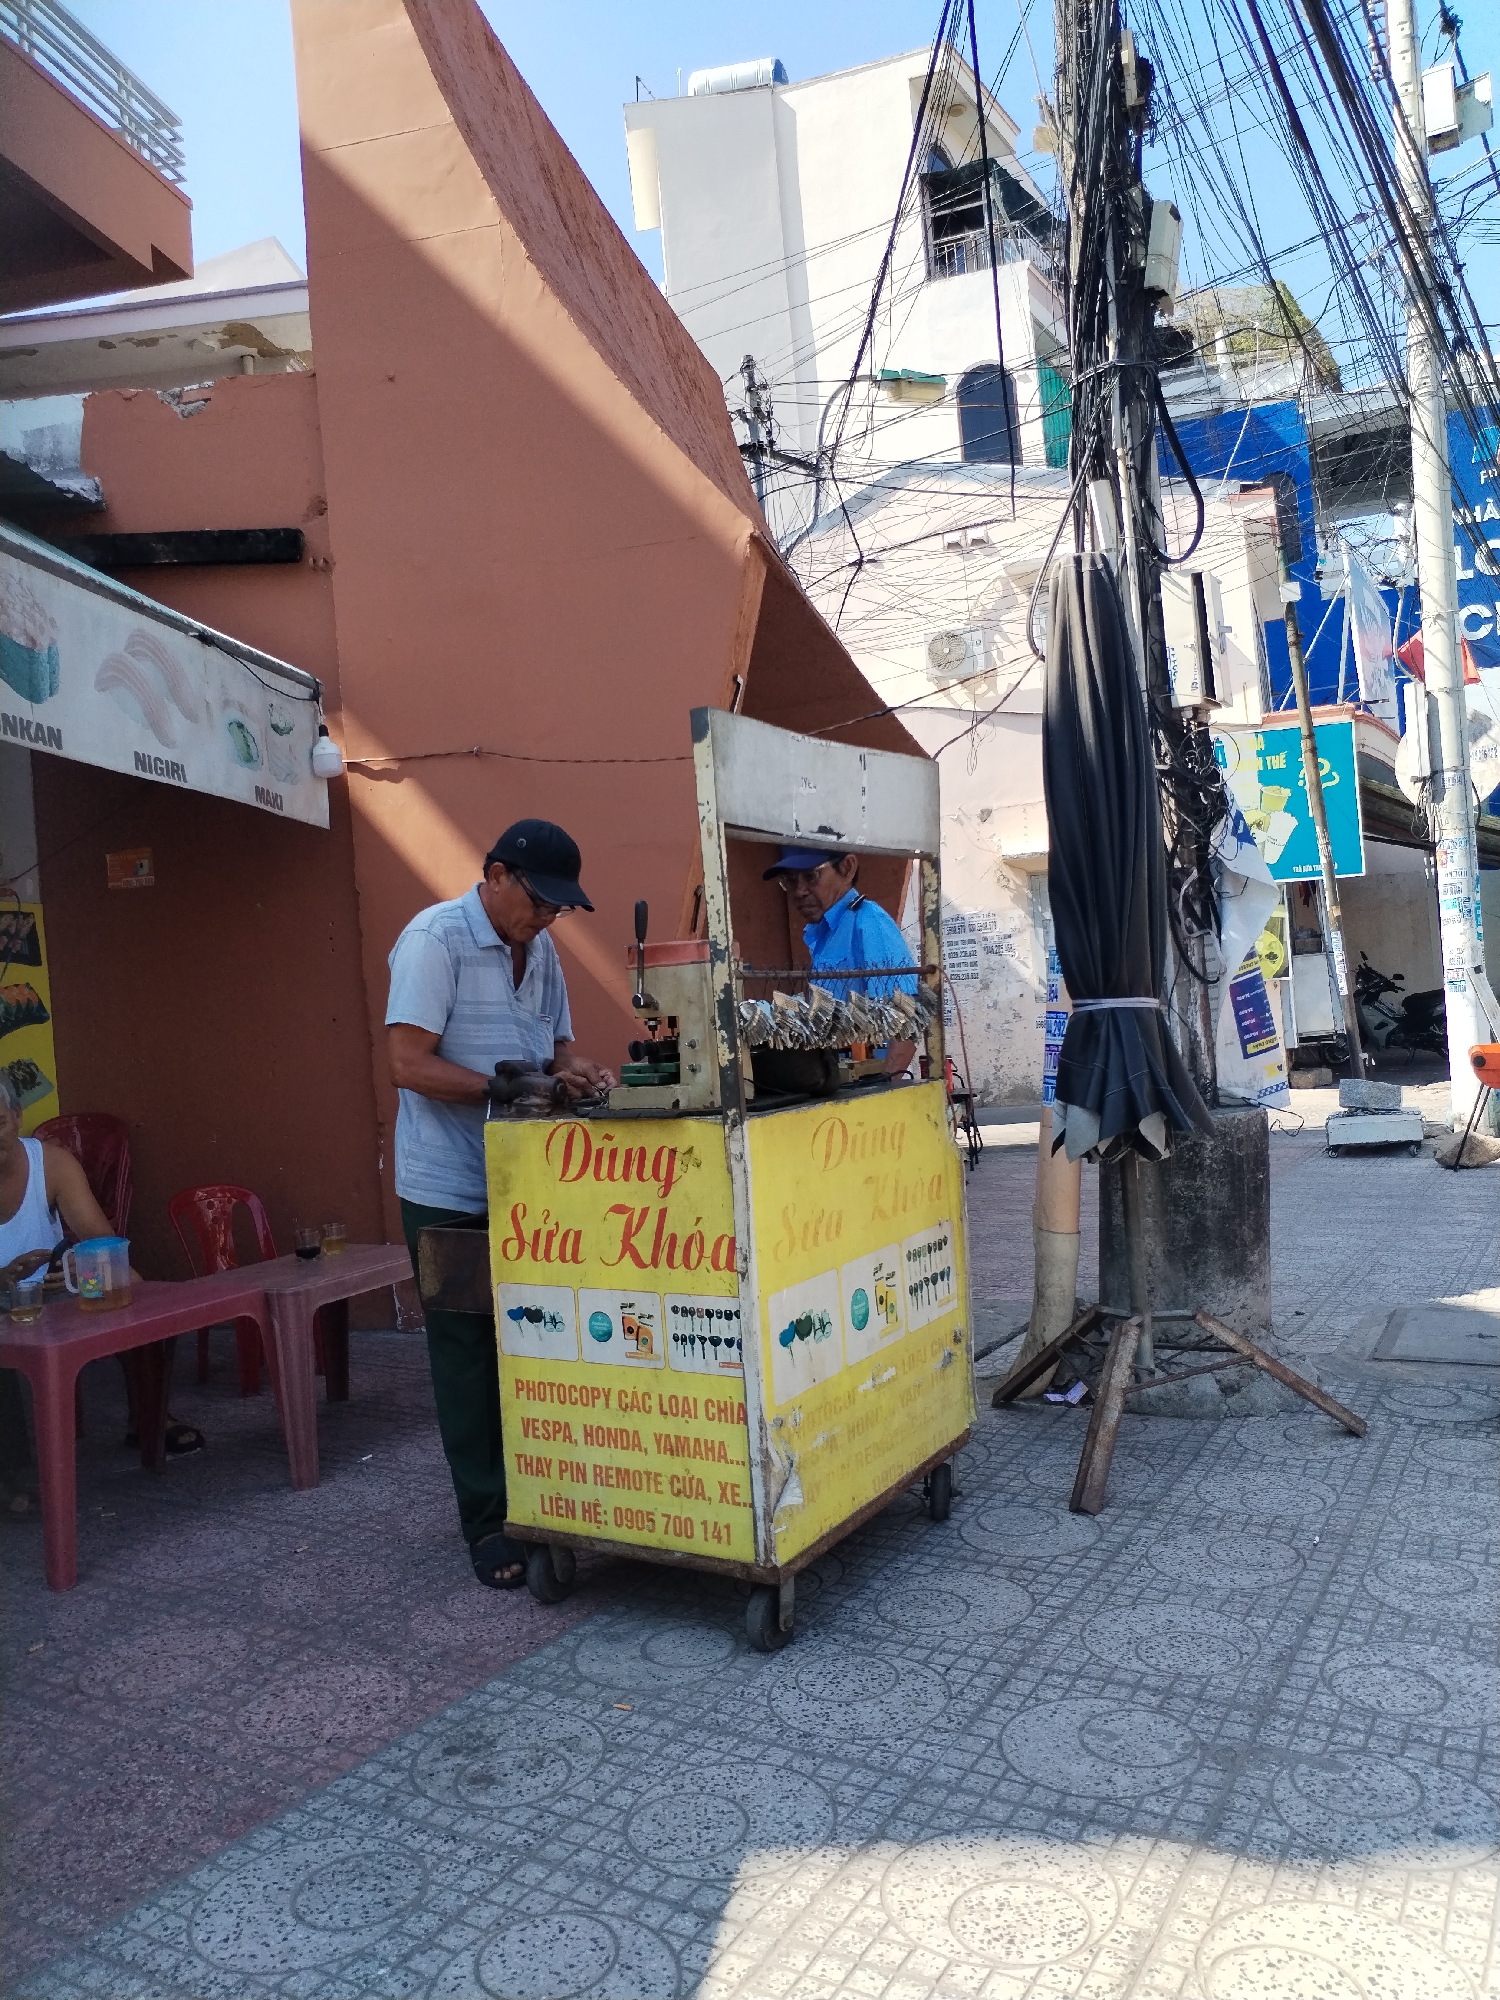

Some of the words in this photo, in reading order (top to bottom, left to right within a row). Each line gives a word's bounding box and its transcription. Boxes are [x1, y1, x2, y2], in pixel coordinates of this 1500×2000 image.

[1, 712, 63, 750] NKAN
[134, 751, 188, 783] NIGIRI
[254, 784, 284, 811] MAKI
[545, 1121, 682, 1198] Dũng
[502, 1202, 586, 1264] Sửa
[600, 1203, 738, 1272] Khóa
[514, 1378, 611, 1409] PHOTOCOPY
[617, 1385, 653, 1414] CÁC
[659, 1393, 698, 1424] LOẠI
[705, 1395, 747, 1426] CHÌA
[521, 1416, 578, 1447] VESPA,
[583, 1423, 648, 1457] HONDA,
[653, 1432, 746, 1467] YAMAHA...
[514, 1453, 552, 1480] THAY
[558, 1458, 588, 1485] PIN
[593, 1464, 664, 1495] REMOTE
[670, 1468, 712, 1505] CỬA,
[540, 1492, 576, 1521] LIÊN
[581, 1498, 608, 1529] HỆ:
[613, 1506, 656, 1533] 0905
[661, 1513, 694, 1540] 700
[701, 1520, 732, 1546] 141
